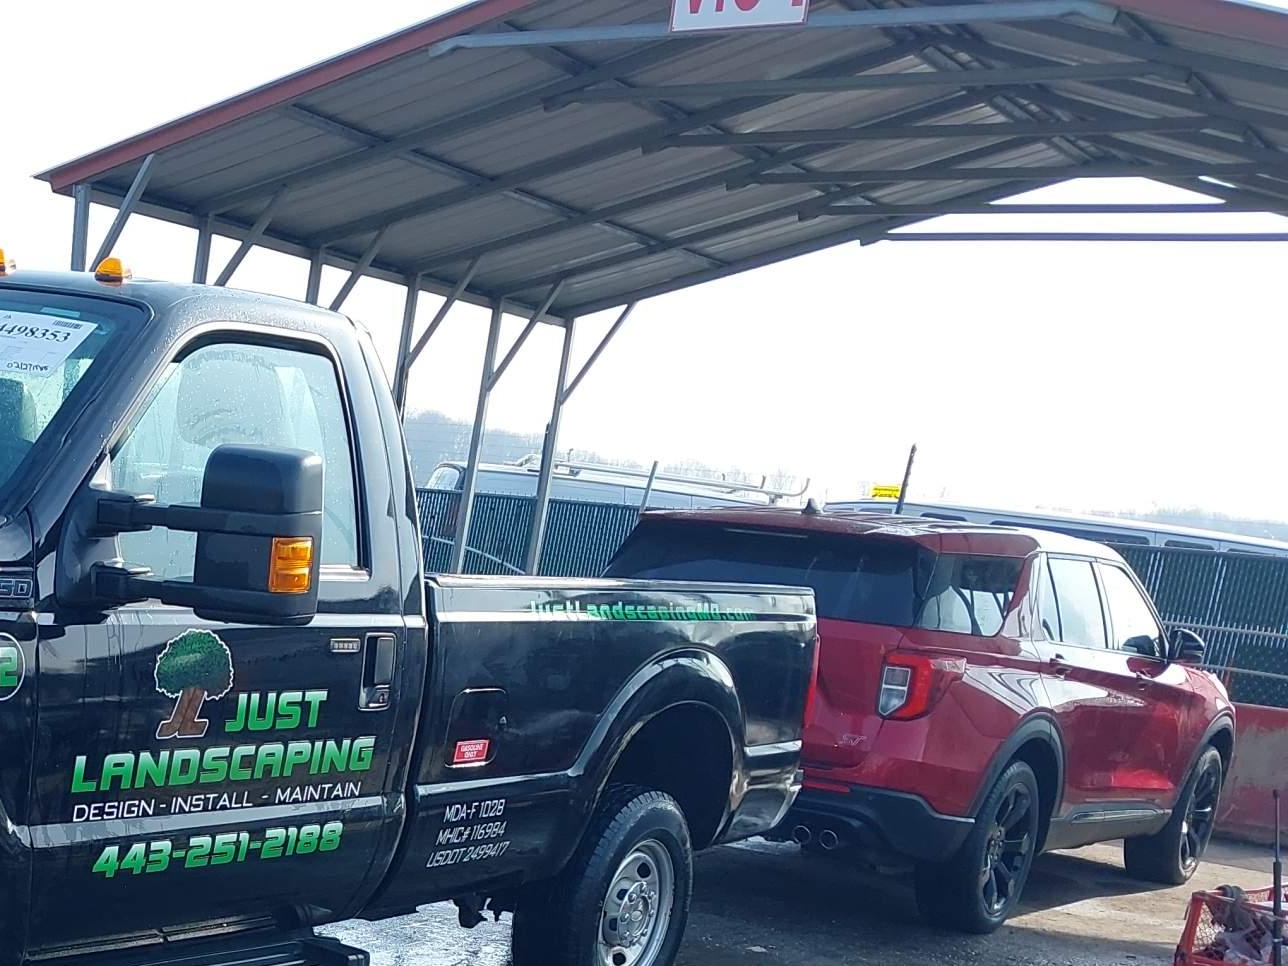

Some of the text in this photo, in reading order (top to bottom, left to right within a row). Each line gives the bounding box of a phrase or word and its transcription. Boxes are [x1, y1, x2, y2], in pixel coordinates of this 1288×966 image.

[224, 688, 328, 733] JUST
[71, 736, 377, 793] LANDSCAPING
[72, 800, 156, 823] DESIGN
[170, 791, 253, 814] INSTALL
[274, 781, 361, 803] MAINTAIN
[443, 799, 506, 823] MDA-F 1028
[91, 821, 344, 878] 443-251-2188
[437, 821, 508, 845] MHIC# 116984
[426, 849, 465, 868] USDOT
